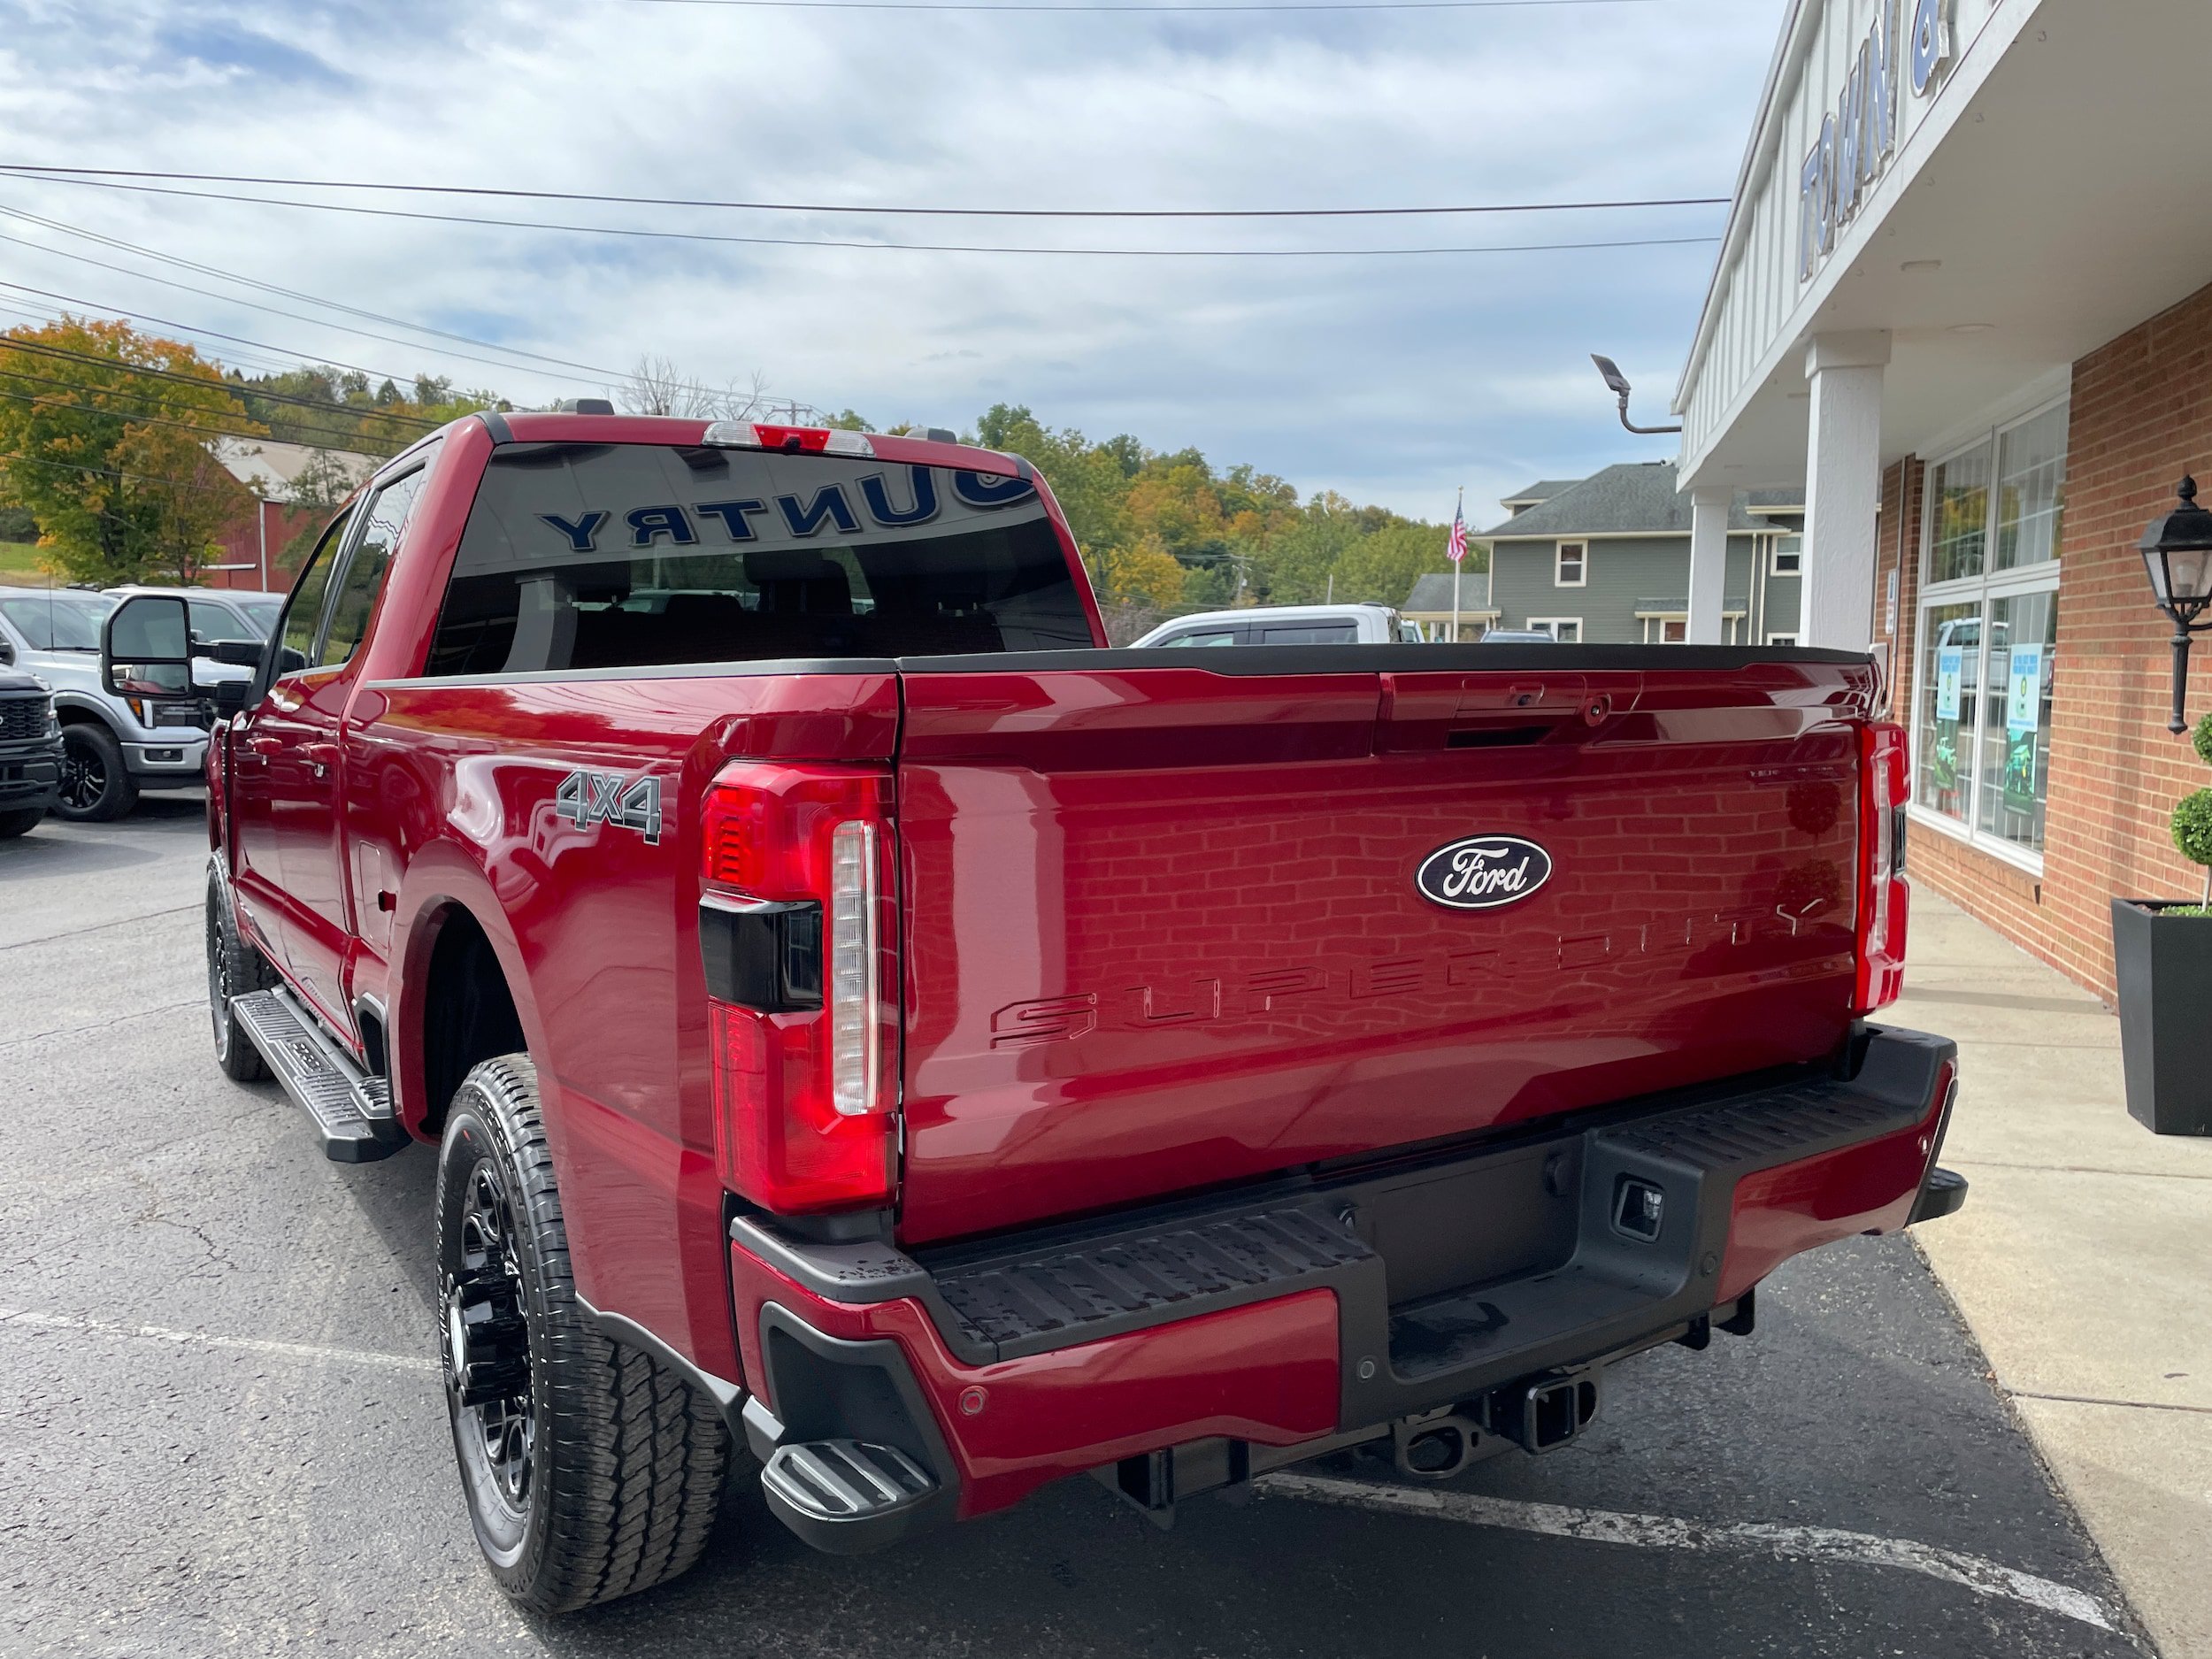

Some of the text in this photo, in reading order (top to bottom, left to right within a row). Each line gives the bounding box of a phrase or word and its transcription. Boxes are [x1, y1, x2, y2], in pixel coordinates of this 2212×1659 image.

[1442, 847, 1530, 898] Ford
[989, 897, 1825, 1050] SUPER DUTY
